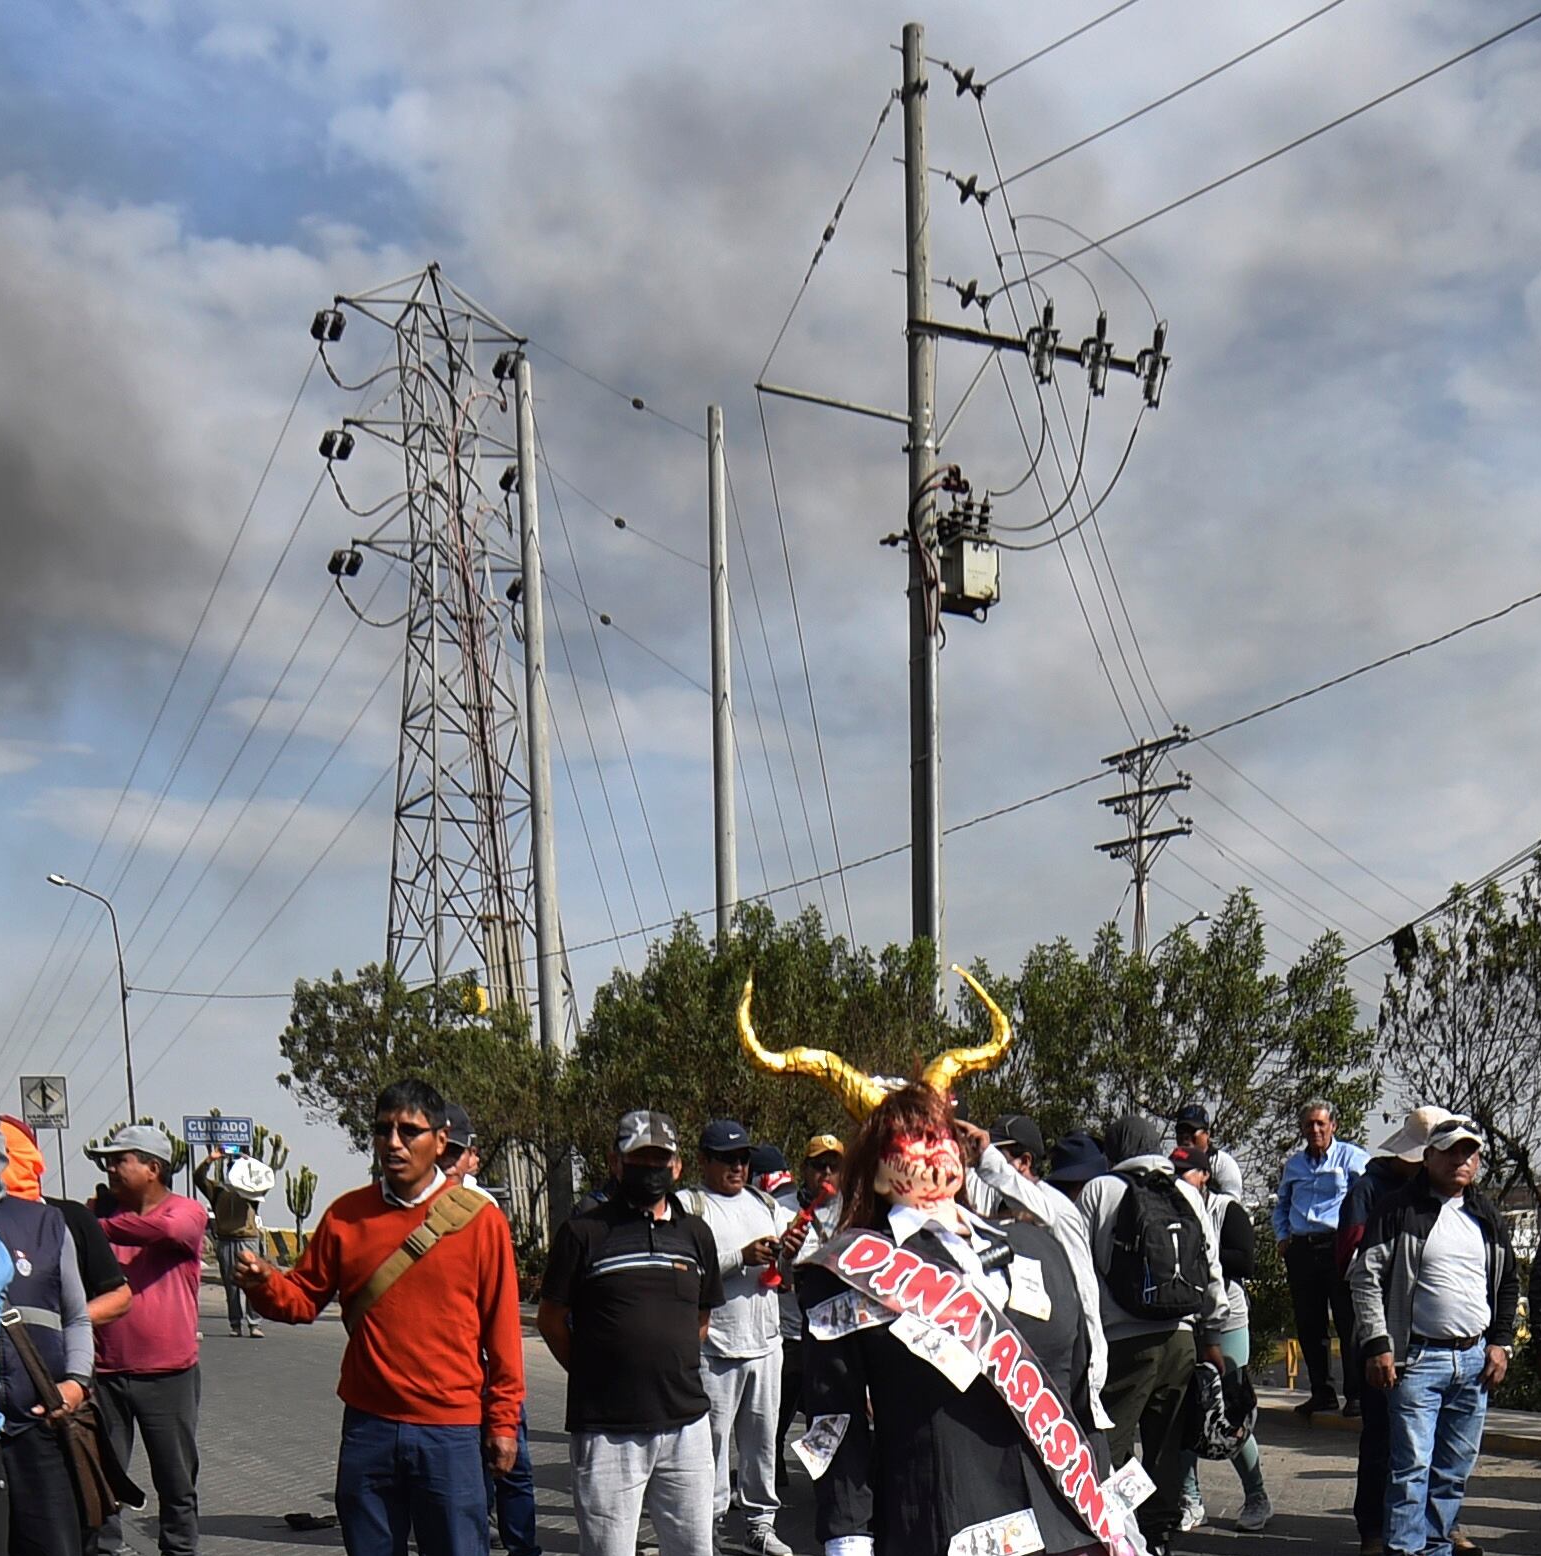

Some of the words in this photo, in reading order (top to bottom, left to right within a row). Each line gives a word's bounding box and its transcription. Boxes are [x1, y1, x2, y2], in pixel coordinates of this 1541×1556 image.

[188, 1121, 248, 1132] CUIDADO
[838, 1234, 985, 1341] DINA
[978, 1330, 1113, 1543] ASESIN
